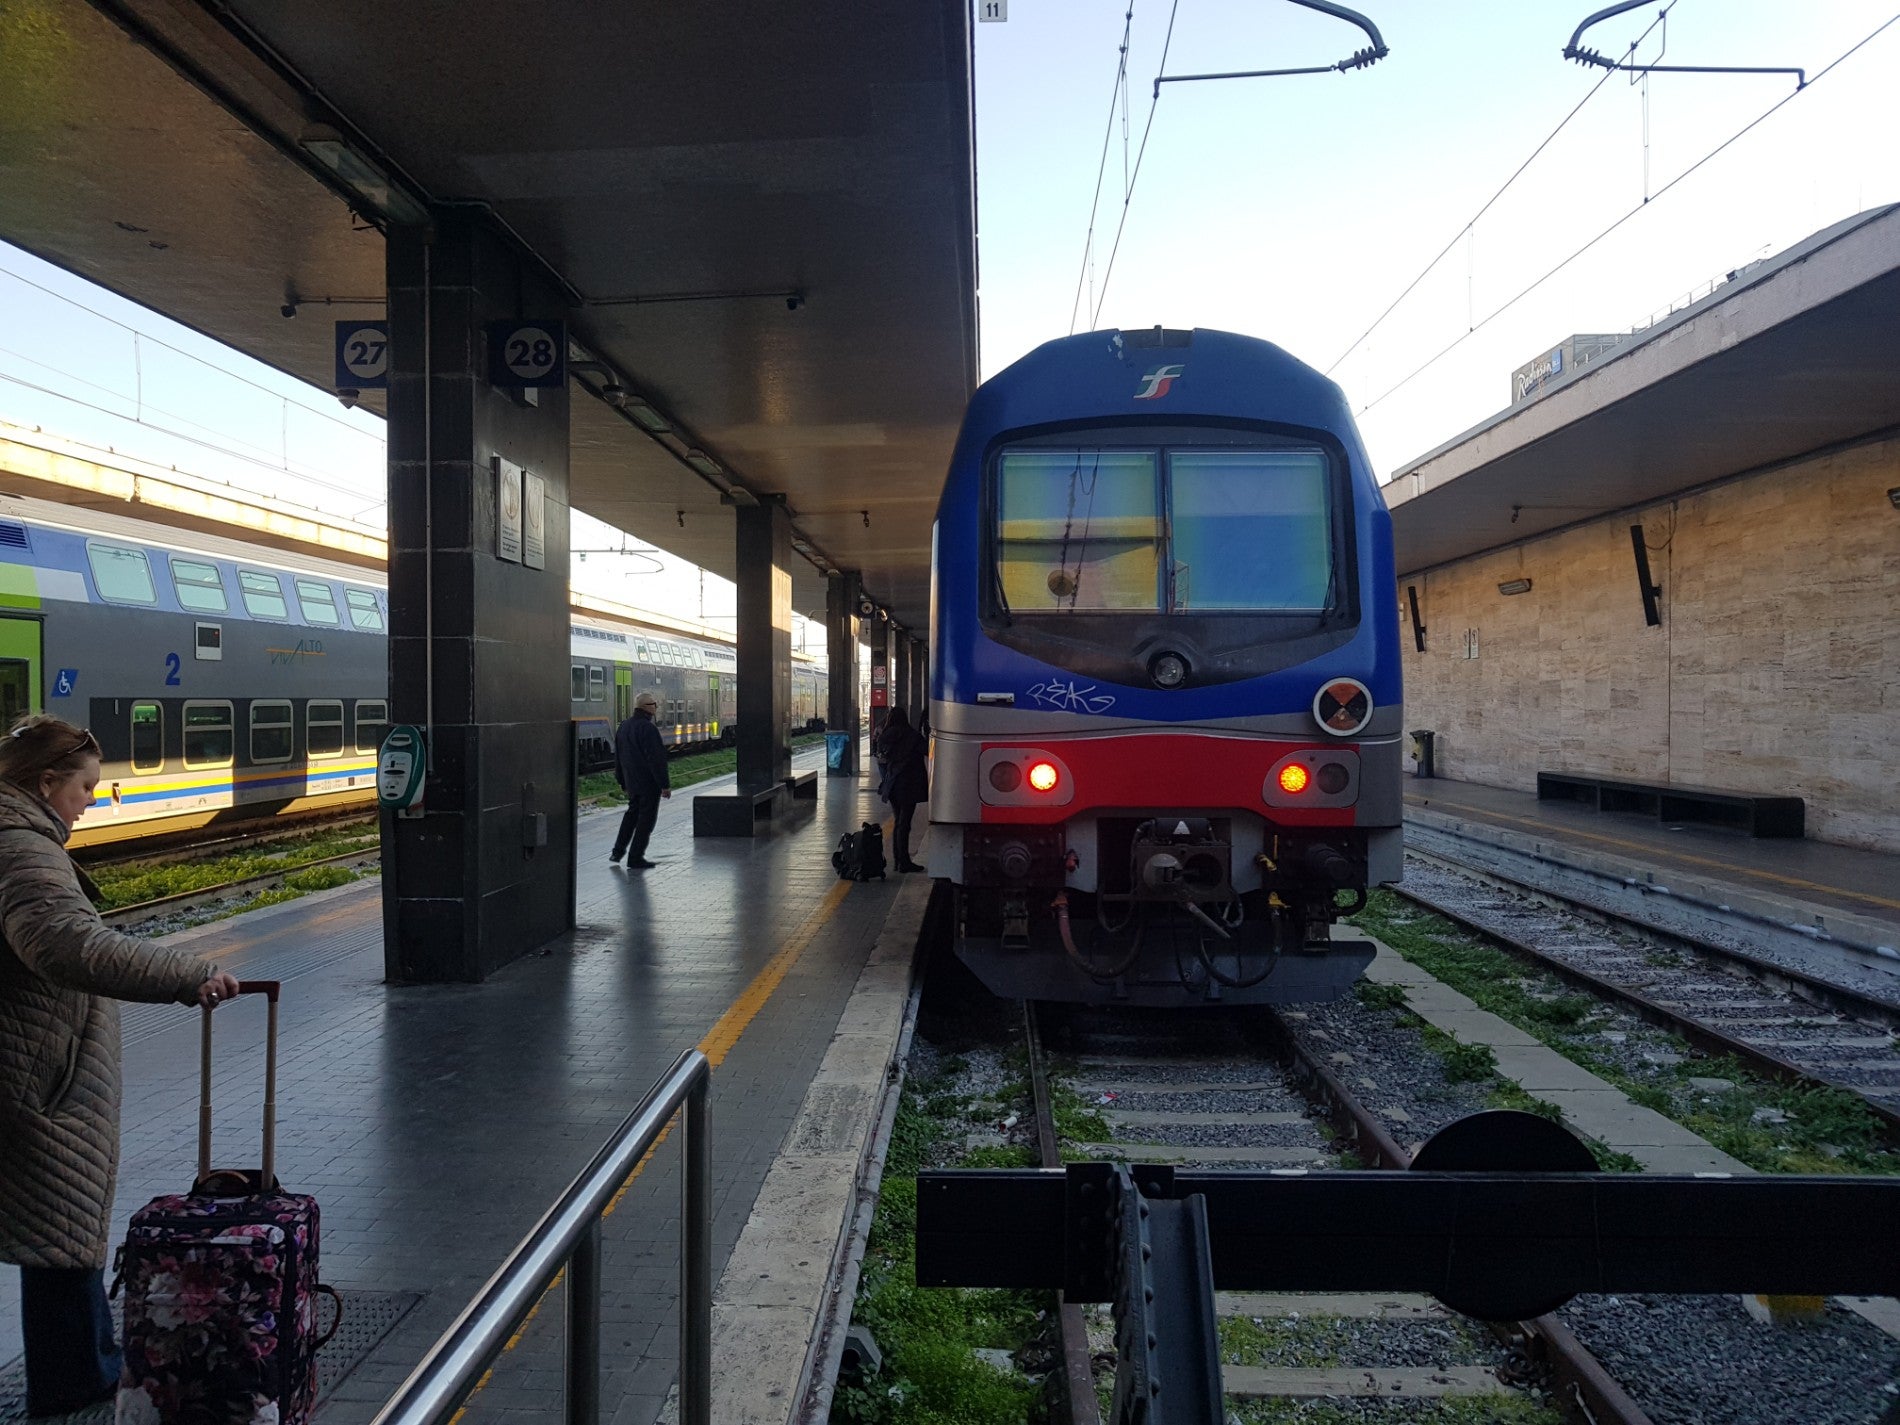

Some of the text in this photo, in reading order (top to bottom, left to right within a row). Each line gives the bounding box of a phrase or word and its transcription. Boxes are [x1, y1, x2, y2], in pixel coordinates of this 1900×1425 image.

[986, 2, 999, 18] 11
[350, 340, 387, 366] 27
[508, 339, 553, 367] 28
[165, 652, 181, 686] 2
